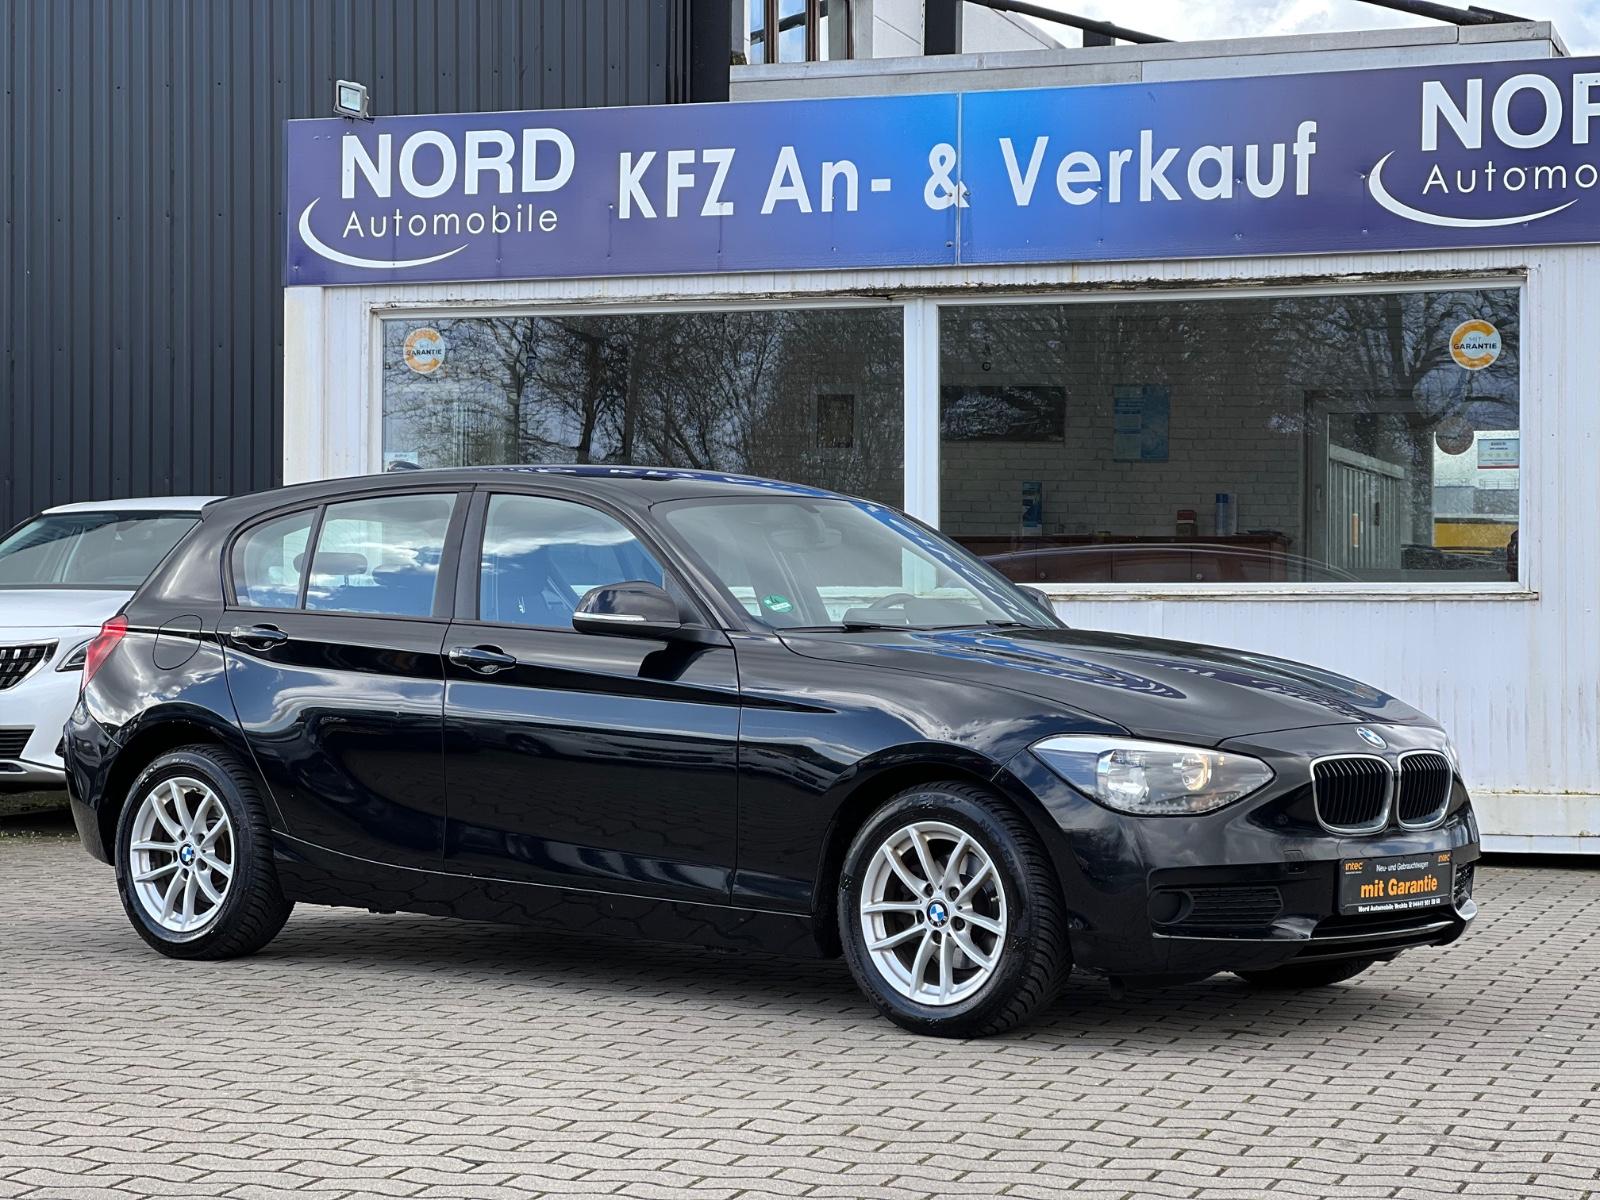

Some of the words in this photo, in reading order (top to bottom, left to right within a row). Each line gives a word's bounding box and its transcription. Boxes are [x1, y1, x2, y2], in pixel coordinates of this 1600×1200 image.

[341, 127, 575, 199] NORD
[618, 148, 736, 219] KFZ
[760, 145, 892, 214] An-
[923, 142, 970, 211] &
[999, 121, 1317, 206] Verkauf
[342, 203, 558, 238] Automobile
[1388, 863, 1397, 871] und
[1360, 880, 1385, 898] mit
[1388, 874, 1438, 896] Garantie
